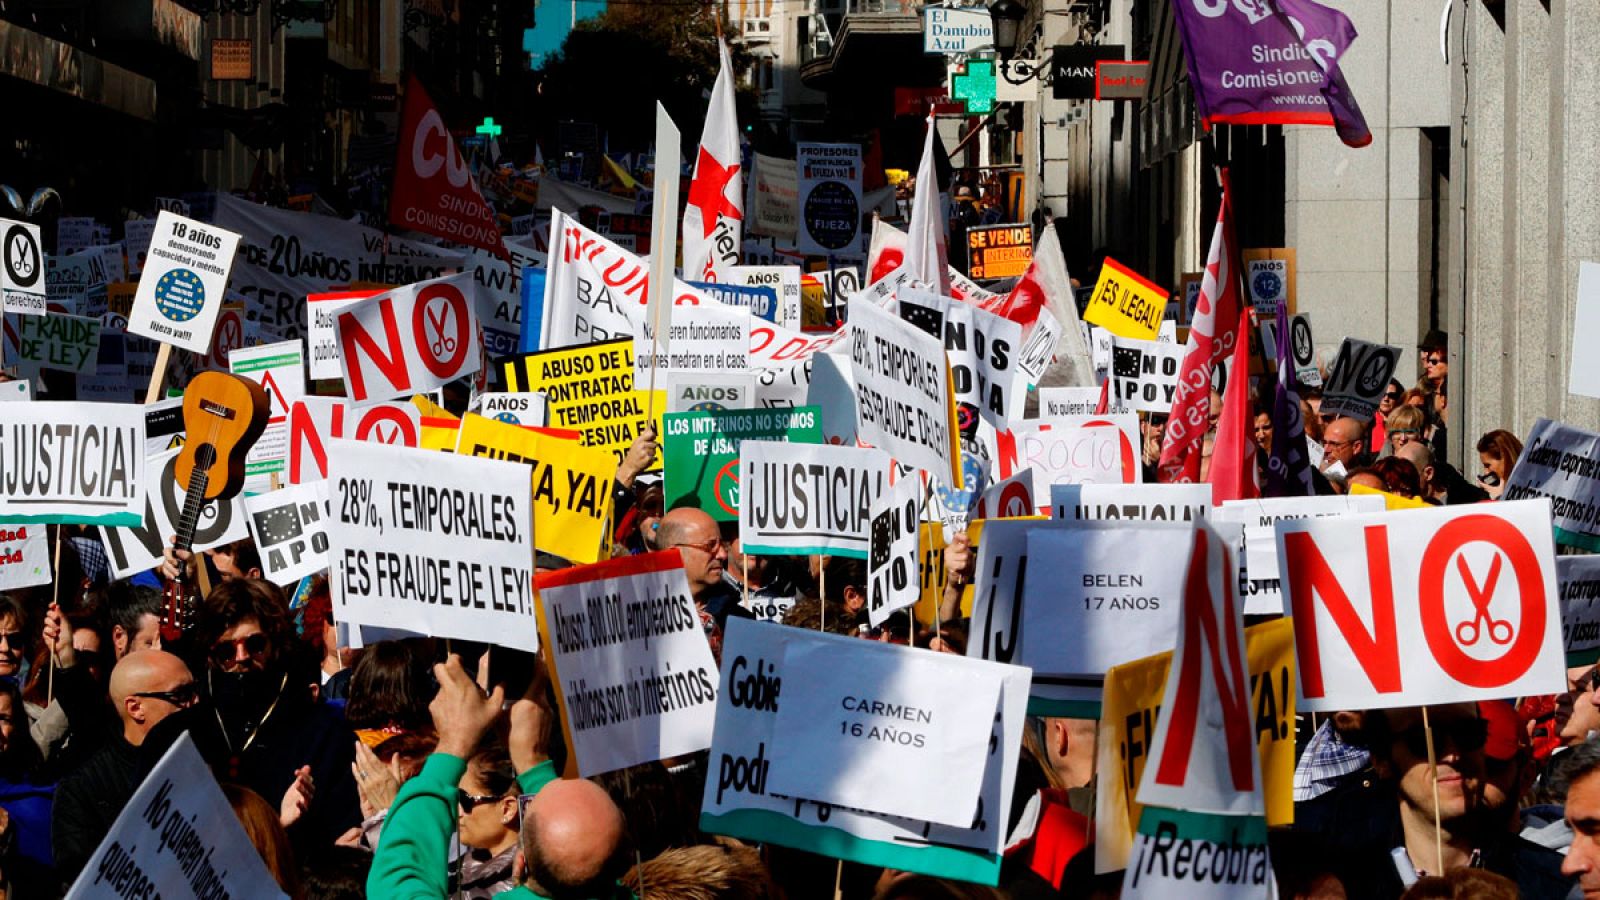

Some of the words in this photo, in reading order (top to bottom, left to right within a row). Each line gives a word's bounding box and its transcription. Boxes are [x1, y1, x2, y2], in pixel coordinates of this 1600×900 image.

[932, 11, 948, 23] El
[932, 24, 991, 36] Danubio
[931, 37, 965, 50] Azul
[1060, 67, 1097, 77] MAN
[438, 193, 493, 222] SINDIC
[171, 221, 188, 238] 18
[187, 227, 222, 249] años
[404, 207, 497, 245] COMISSIONS
[815, 219, 850, 230] FIJEZA
[970, 231, 987, 249] SE
[987, 227, 1032, 247] VENDE
[152, 247, 190, 266] capacidad
[167, 238, 216, 261] demostrando
[268, 234, 300, 278] 20
[300, 252, 351, 282] AÑOS
[747, 271, 780, 285] AÑOS
[1263, 279, 1275, 290] 12
[315, 307, 333, 329] Abus
[1094, 279, 1120, 306] ¡ES
[1117, 288, 1161, 333] ILEGAL!
[21, 314, 100, 347] FRAUDE
[338, 283, 470, 402] NO
[689, 321, 741, 340] funcionarios
[21, 340, 43, 361] DE
[50, 343, 90, 371] LEY
[541, 354, 594, 381] ABUSO
[598, 351, 621, 371] DE
[624, 349, 634, 367] L
[638, 349, 669, 373] quines
[670, 349, 702, 368] medran
[703, 354, 715, 369] en
[716, 350, 725, 369] el
[851, 325, 874, 378] 28%,
[1326, 341, 1394, 398] NO
[486, 395, 529, 410] AÑOS
[681, 384, 739, 401] AÑOS
[951, 364, 1004, 417] OYA
[556, 397, 644, 427] TEMPORAL
[1047, 401, 1058, 415] No
[667, 418, 689, 436] LOS
[692, 415, 753, 435] INTERINOS
[755, 413, 779, 431] NO
[782, 411, 815, 430] SOMOS
[694, 439, 709, 456] DE
[567, 469, 609, 520] YA!
[339, 477, 384, 536] 28%,
[387, 481, 523, 543] TEMPORALES.
[340, 549, 371, 605] ¡ES
[375, 551, 453, 606] FRAUDE
[457, 561, 486, 609] DE
[489, 565, 533, 616] LEY!
[1082, 574, 1143, 588] BELEN
[751, 600, 788, 620] ÑOS
[1083, 597, 1105, 610] 17
[1109, 593, 1160, 610] AÑOS
[1284, 513, 1547, 698] NO
[626, 584, 694, 651] empleados
[728, 655, 782, 713] Gobie
[841, 695, 933, 725] CARMEN
[841, 720, 863, 738] 16
[867, 724, 926, 749] AÑOS
[142, 778, 174, 831] No
[156, 808, 204, 880] quieren
